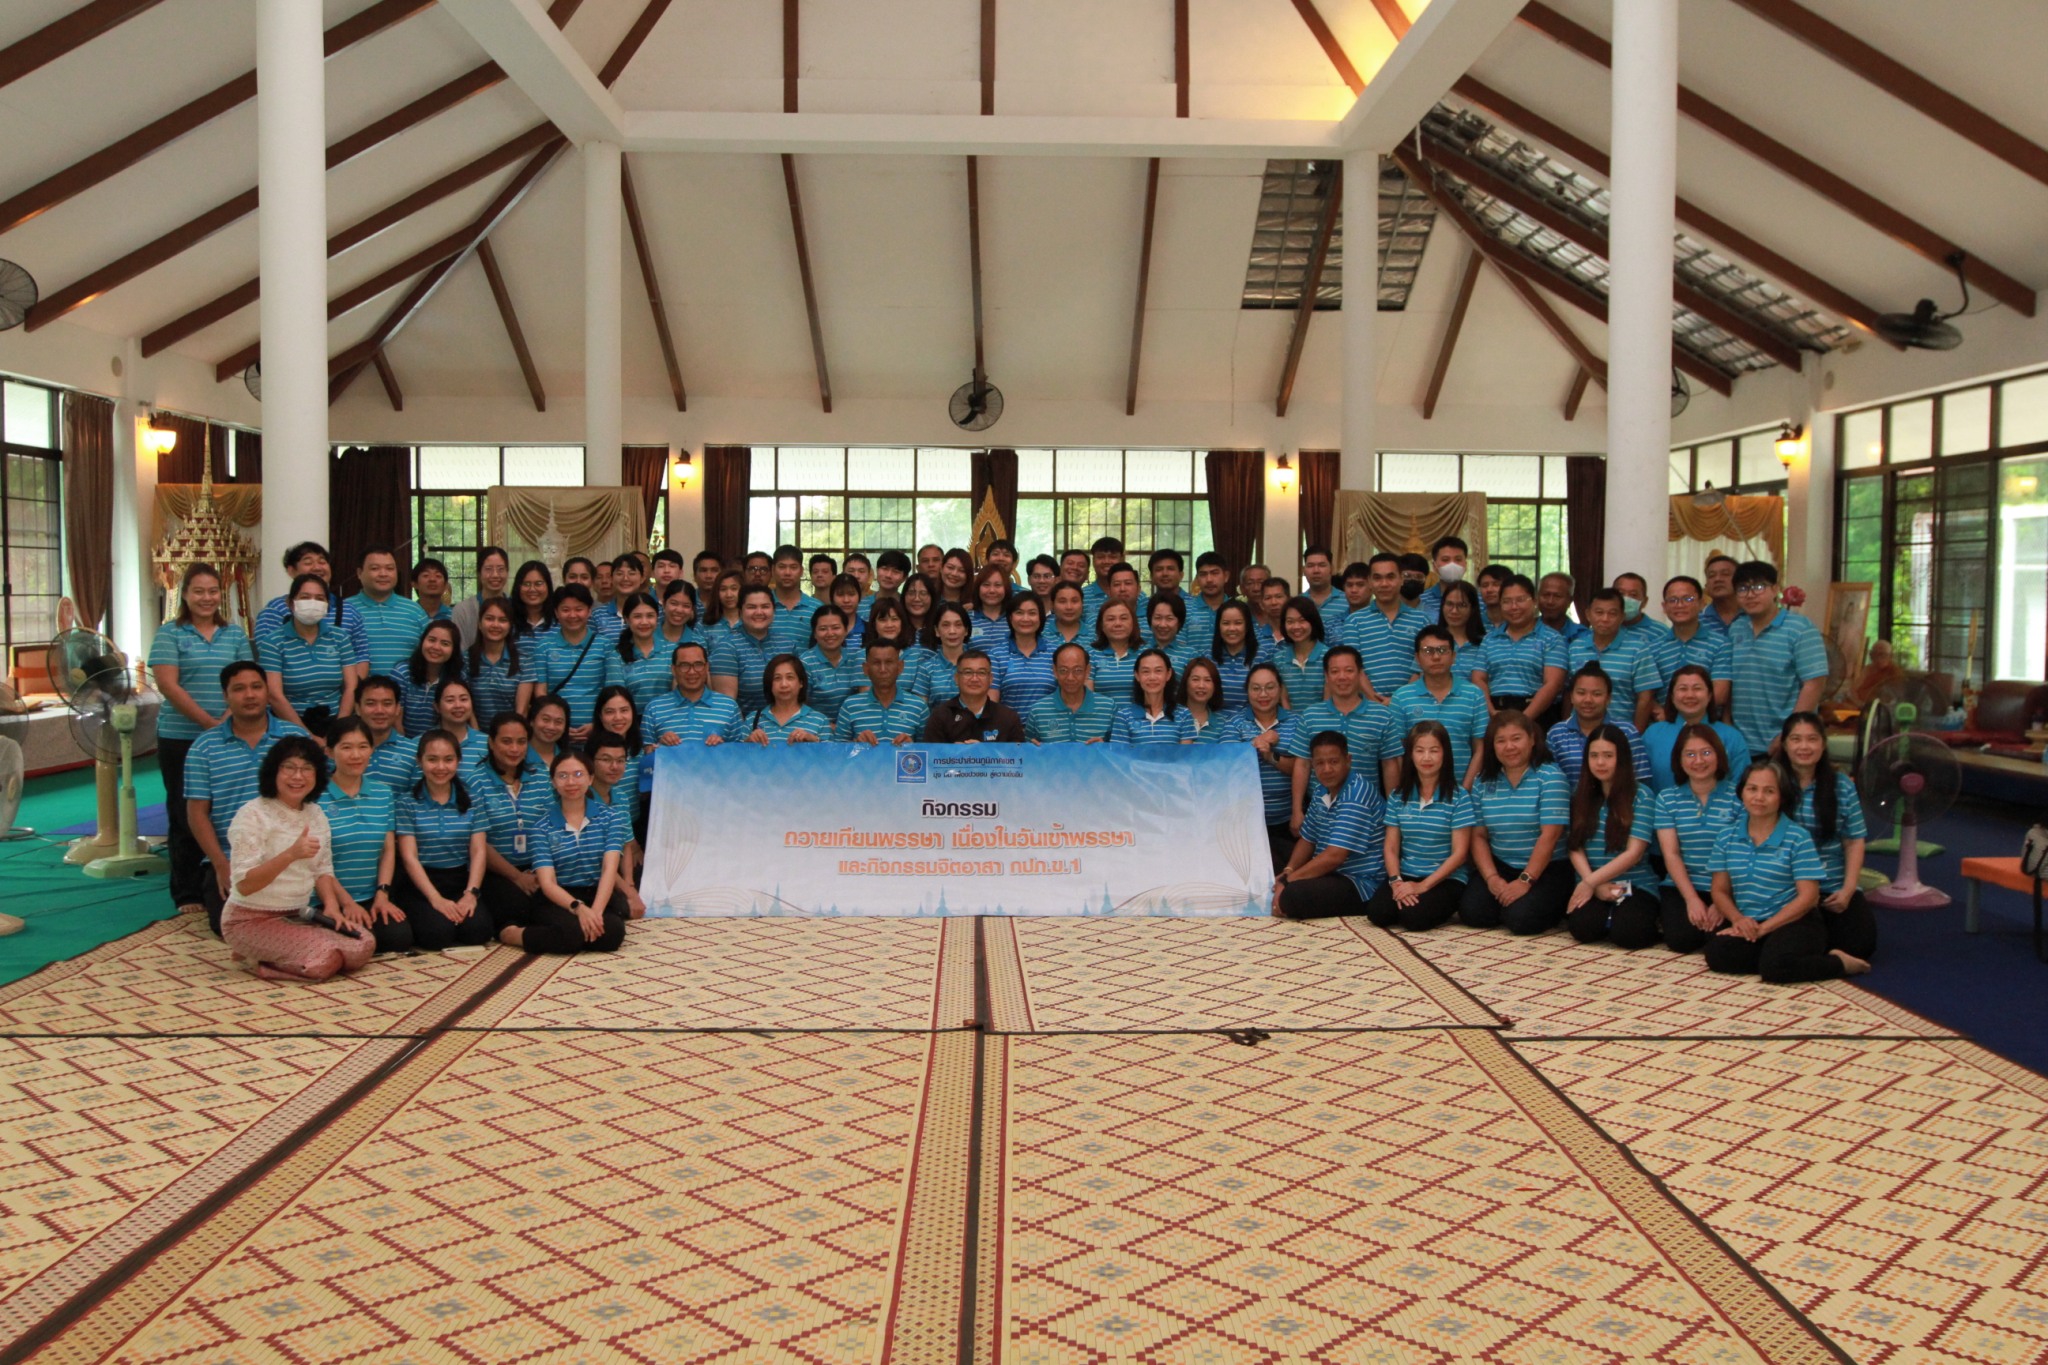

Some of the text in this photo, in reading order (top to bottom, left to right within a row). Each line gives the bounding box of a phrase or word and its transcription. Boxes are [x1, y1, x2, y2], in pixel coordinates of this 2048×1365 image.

[921, 799, 997, 816] กิจกรรม
[784, 823, 1134, 848] ถวายเทียนพรรษา เนื่องในวันเข้าพรรษา
[838, 857, 1081, 875] และกิจกรรมจิตอาสา กปภ.ข.1
